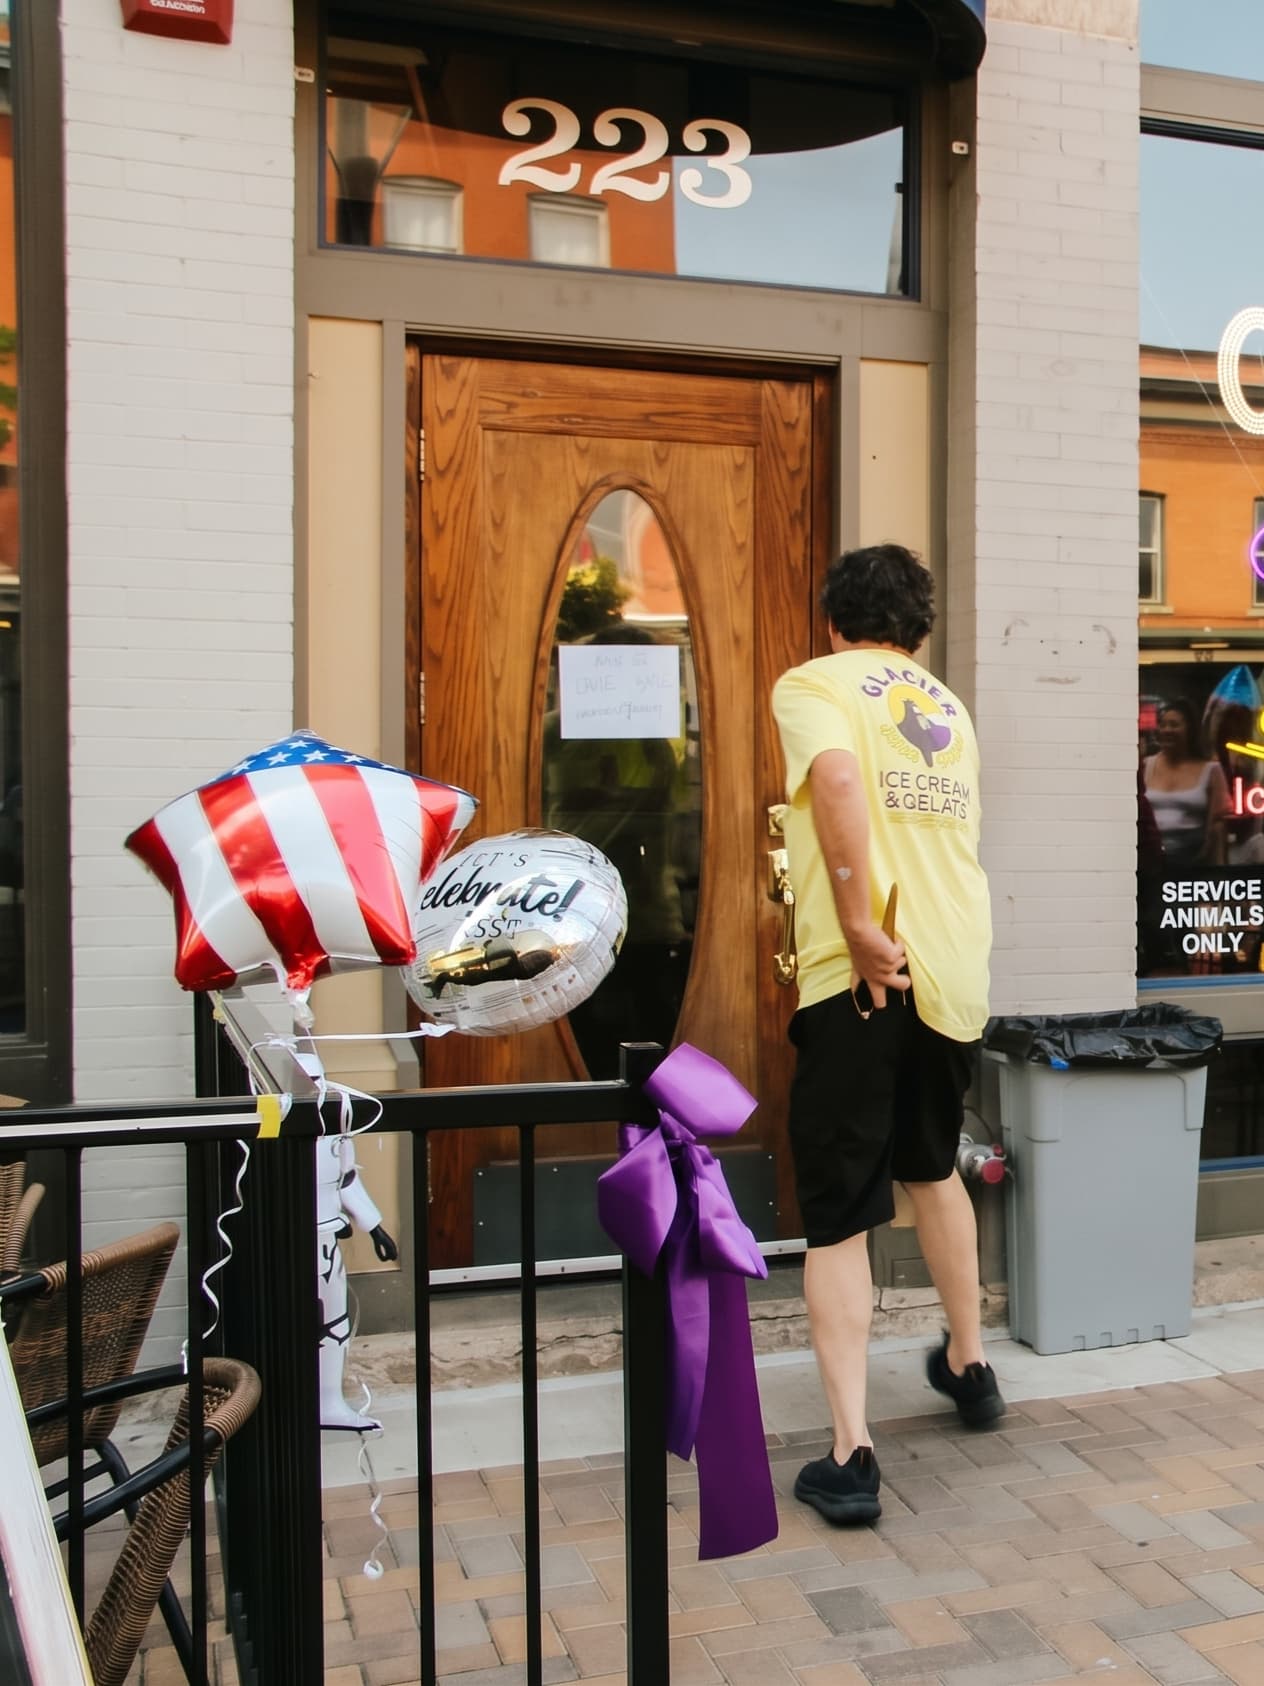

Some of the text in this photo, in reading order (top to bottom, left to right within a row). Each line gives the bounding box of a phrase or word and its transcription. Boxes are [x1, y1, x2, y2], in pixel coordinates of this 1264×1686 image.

[498, 97, 752, 208] 223
[861, 667, 957, 717] GLACIER
[880, 771, 970, 805] ICE CREAM
[885, 791, 967, 819] & GELATS
[420, 866, 586, 922] elebrate!
[1162, 879, 1262, 903] SERVICE
[1160, 905, 1264, 929] ANIMALS
[1182, 932, 1244, 954] ONLY
